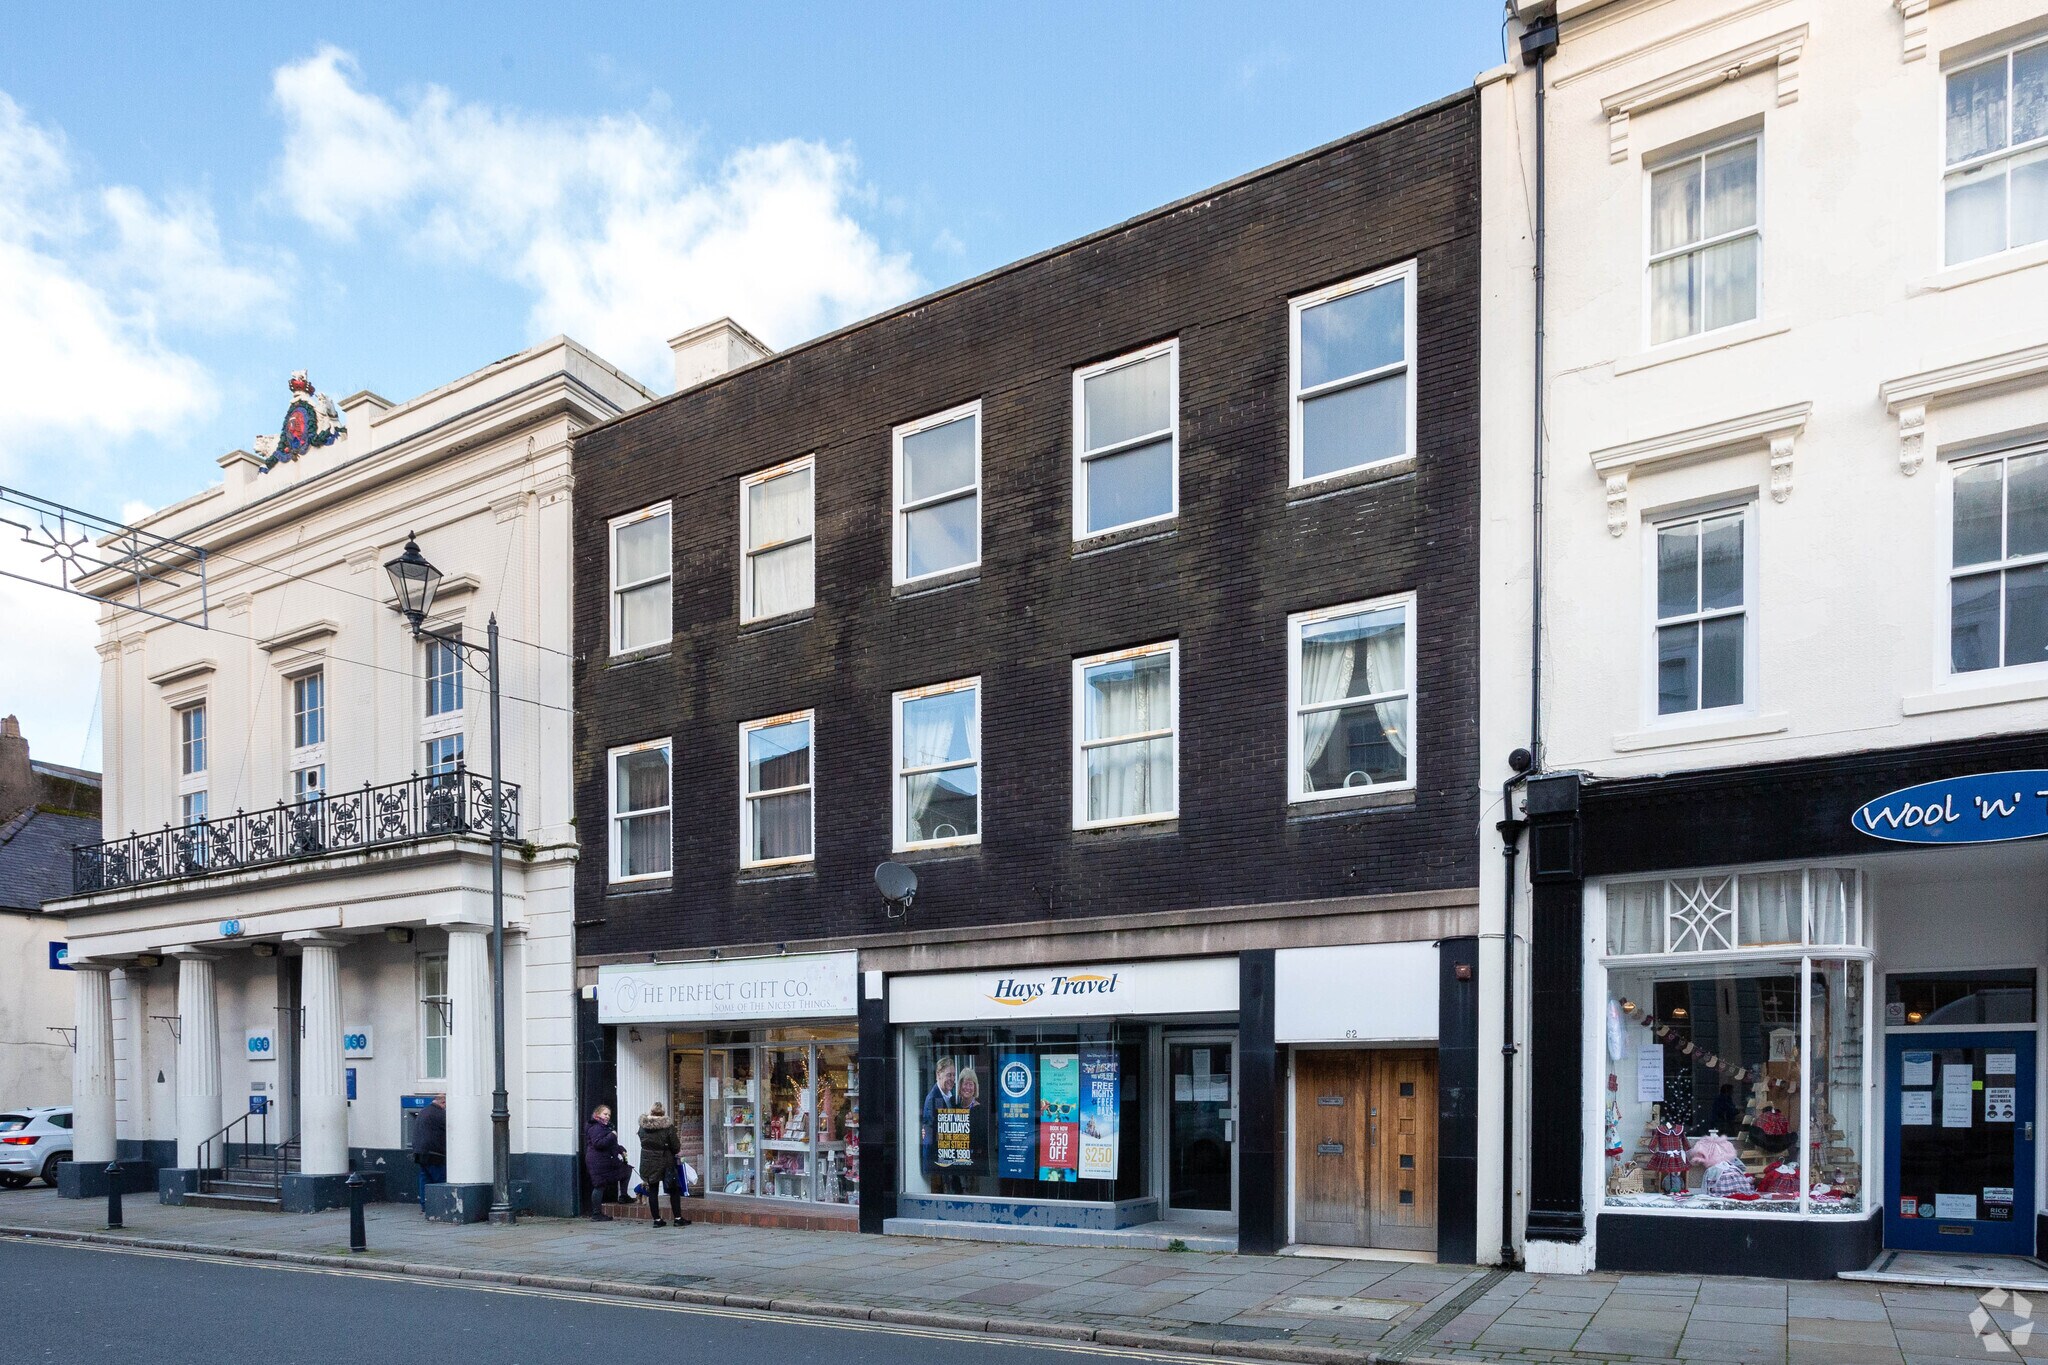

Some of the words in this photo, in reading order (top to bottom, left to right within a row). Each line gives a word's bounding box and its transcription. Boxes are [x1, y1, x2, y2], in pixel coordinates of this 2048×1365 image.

[1863, 794, 1960, 830] Wool
[1975, 792, 2021, 819] 'n'
[670, 983, 734, 1002] PERFECT
[740, 981, 778, 999] GIFT
[994, 979, 1045, 1001] Hays
[1051, 973, 1118, 996] Travel
[1346, 1030, 1358, 1038] 62
[1008, 1072, 1025, 1081] FREE
[1097, 1098, 1113, 1106] FREE
[954, 1114, 970, 1122] VALUE
[938, 1122, 970, 1133] HOLIDAYS
[1050, 1132, 1068, 1146] £50
[938, 1149, 955, 1158] SINCE
[956, 1149, 970, 1159] 1980
[1050, 1146, 1068, 1160] OFF
[1085, 1147, 1112, 1163] $250
